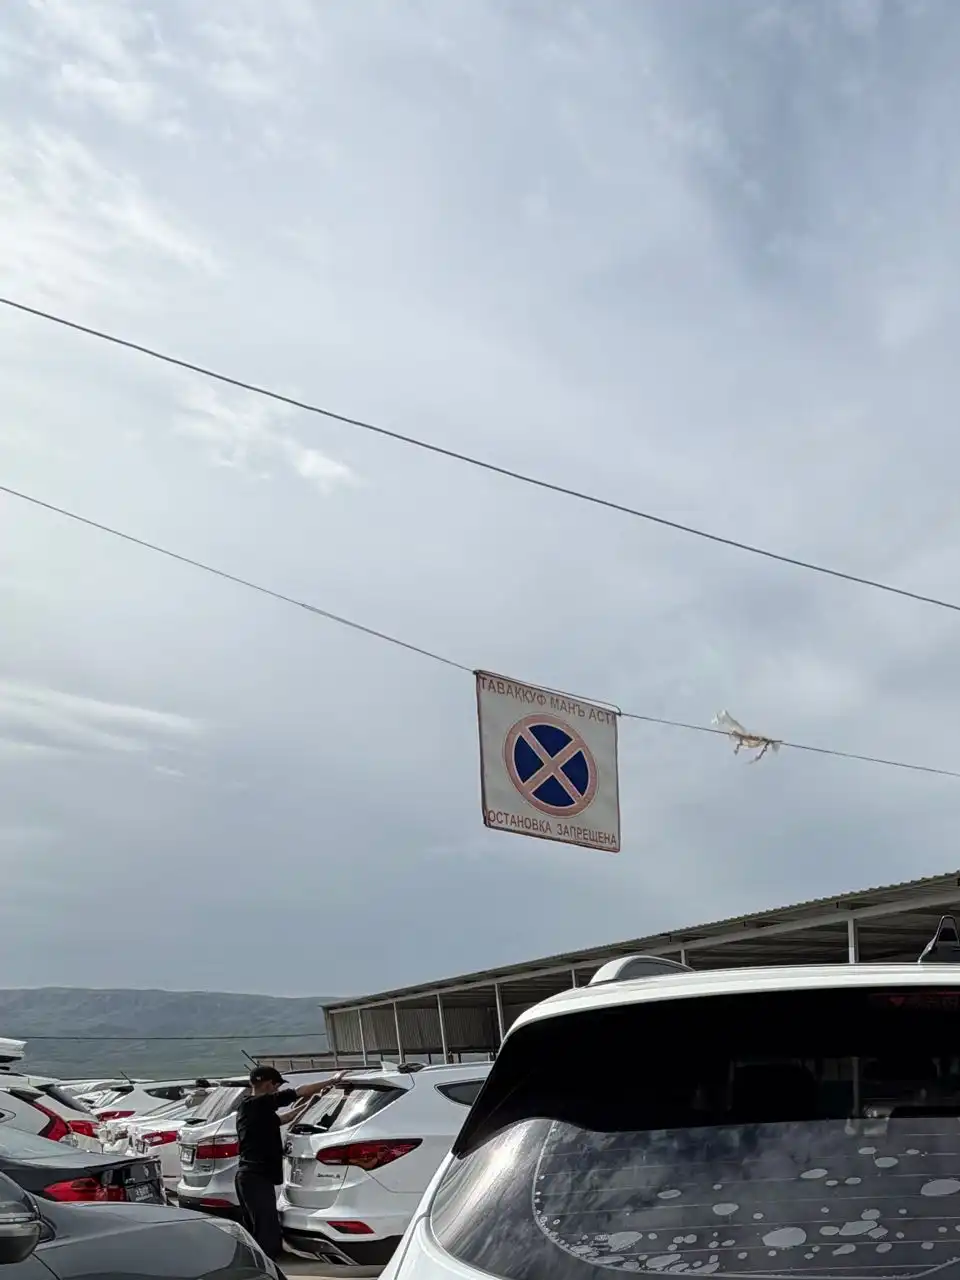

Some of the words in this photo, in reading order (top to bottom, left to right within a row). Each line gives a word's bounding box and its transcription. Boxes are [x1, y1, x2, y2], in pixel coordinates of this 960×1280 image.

[550, 696, 586, 718] МАНЪ
[488, 809, 552, 834] ОСТАНОВКА
[556, 822, 617, 846] ЗАПРЕЩЕНА
